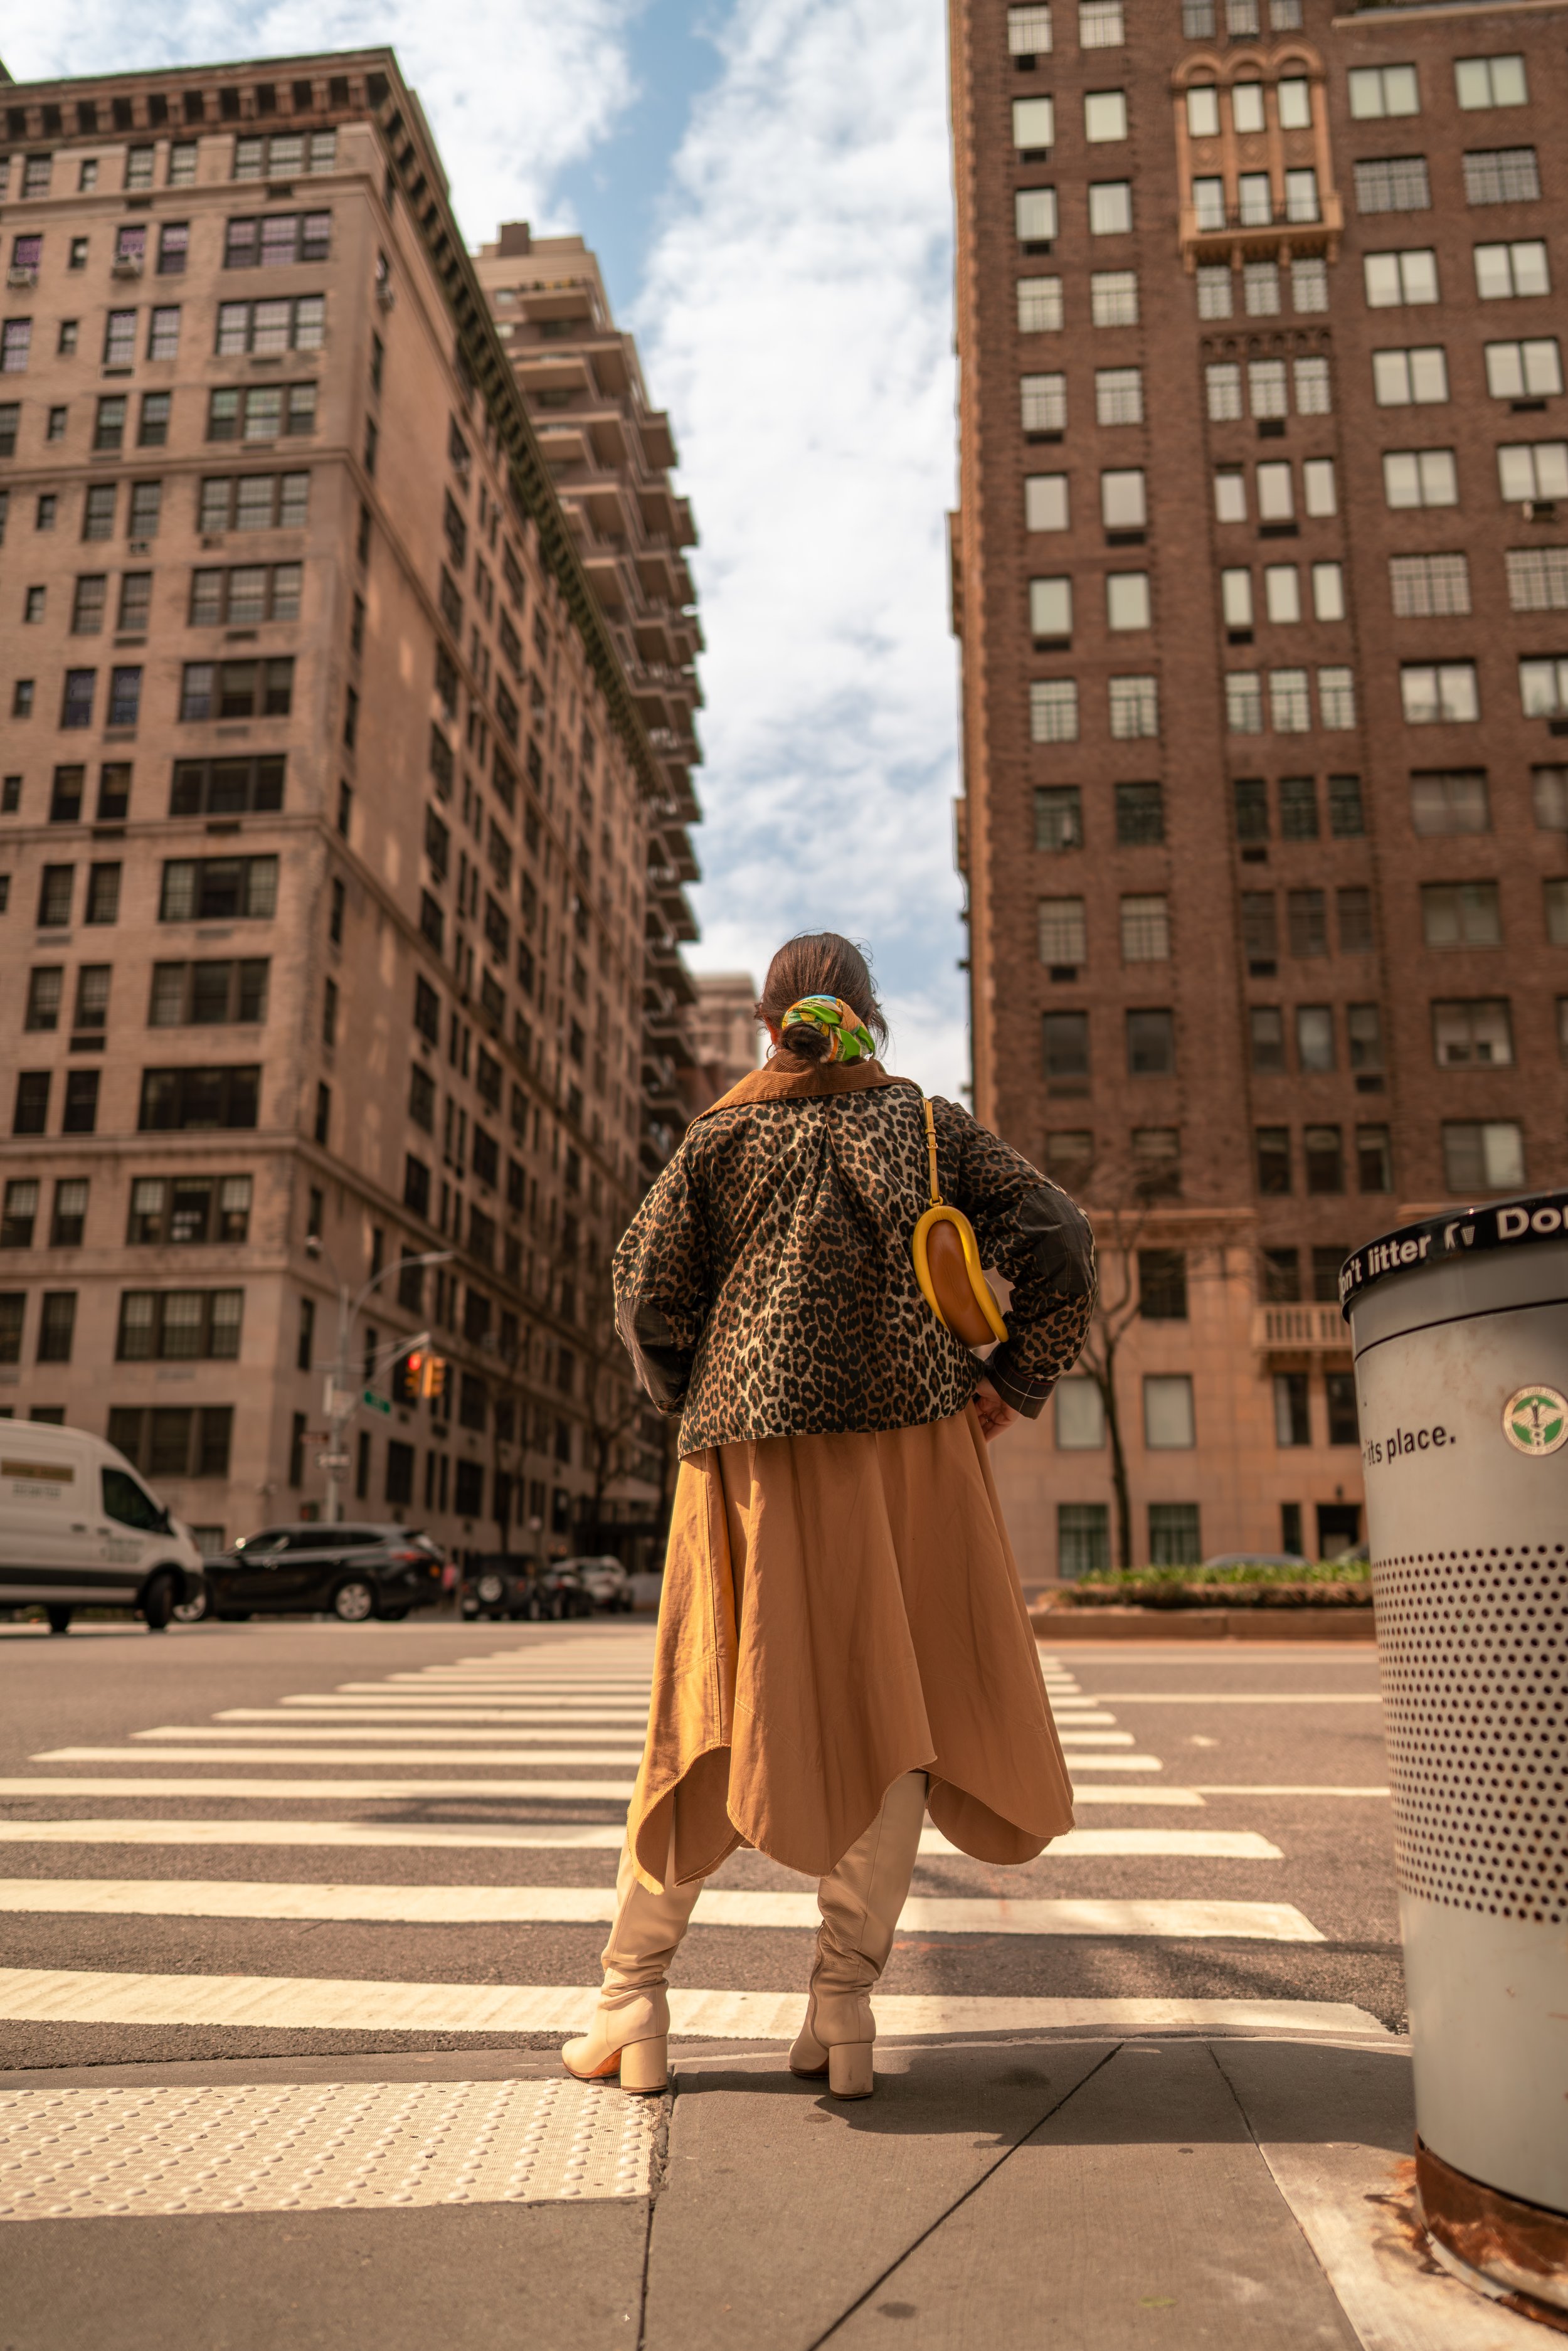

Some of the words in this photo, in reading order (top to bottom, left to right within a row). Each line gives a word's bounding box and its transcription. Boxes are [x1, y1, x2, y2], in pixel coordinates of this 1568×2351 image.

[1496, 1205, 1568, 1240] Do
[1368, 1234, 1432, 1276] litter
[1367, 1440, 1382, 1466] its
[1387, 1425, 1456, 1465] place.
